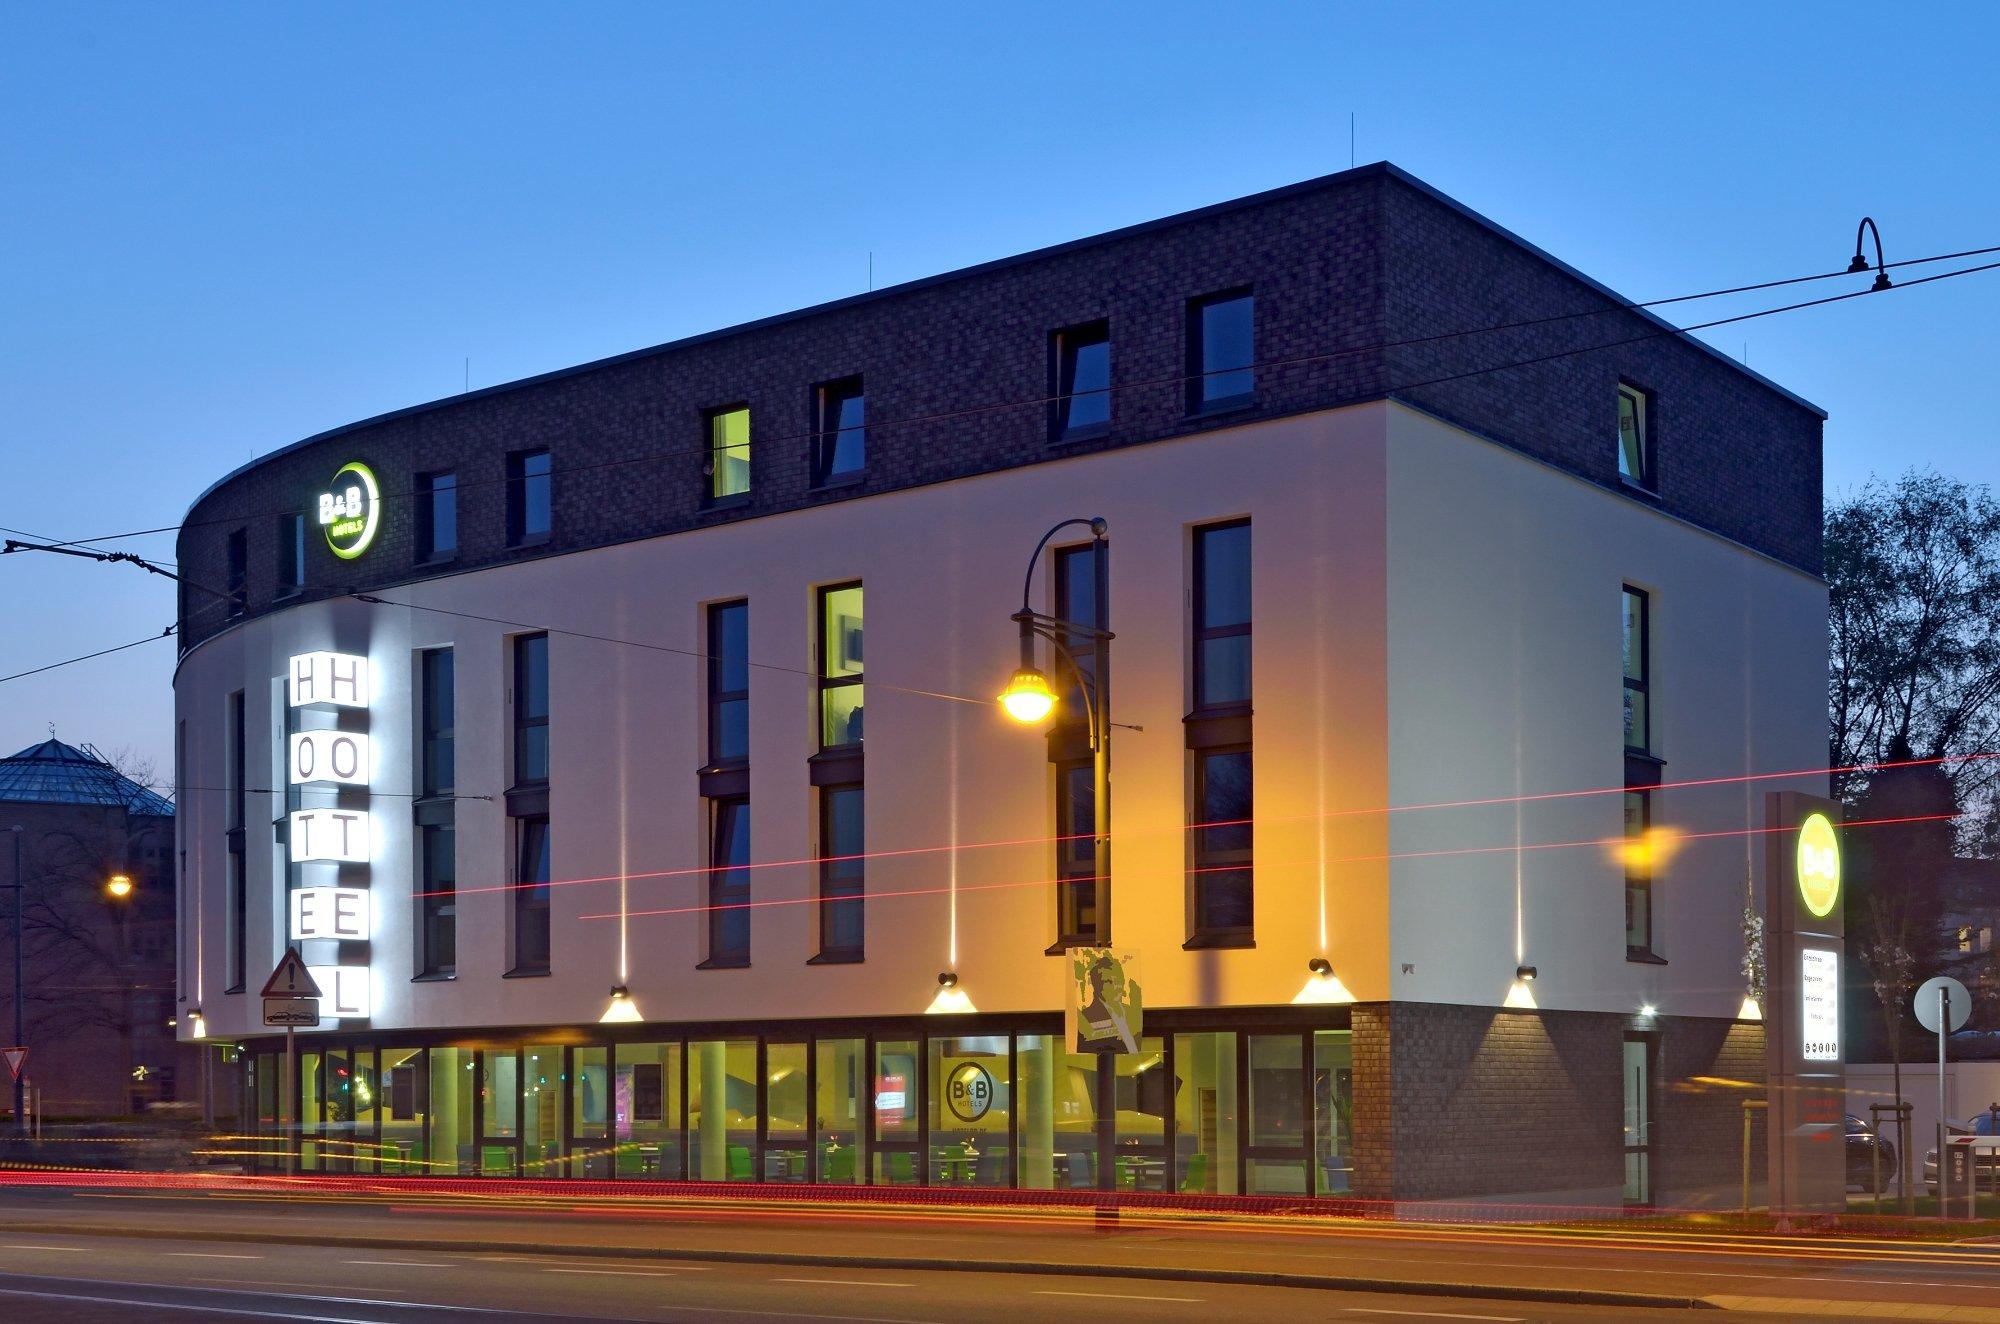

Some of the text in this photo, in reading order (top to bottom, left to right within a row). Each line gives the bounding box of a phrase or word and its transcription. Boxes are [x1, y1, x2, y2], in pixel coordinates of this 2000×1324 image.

[320, 486, 362, 524] B&B
[297, 657, 315, 935] HOTE
[331, 657, 359, 1013] HOTEL
[953, 1080, 988, 1099] B&B
